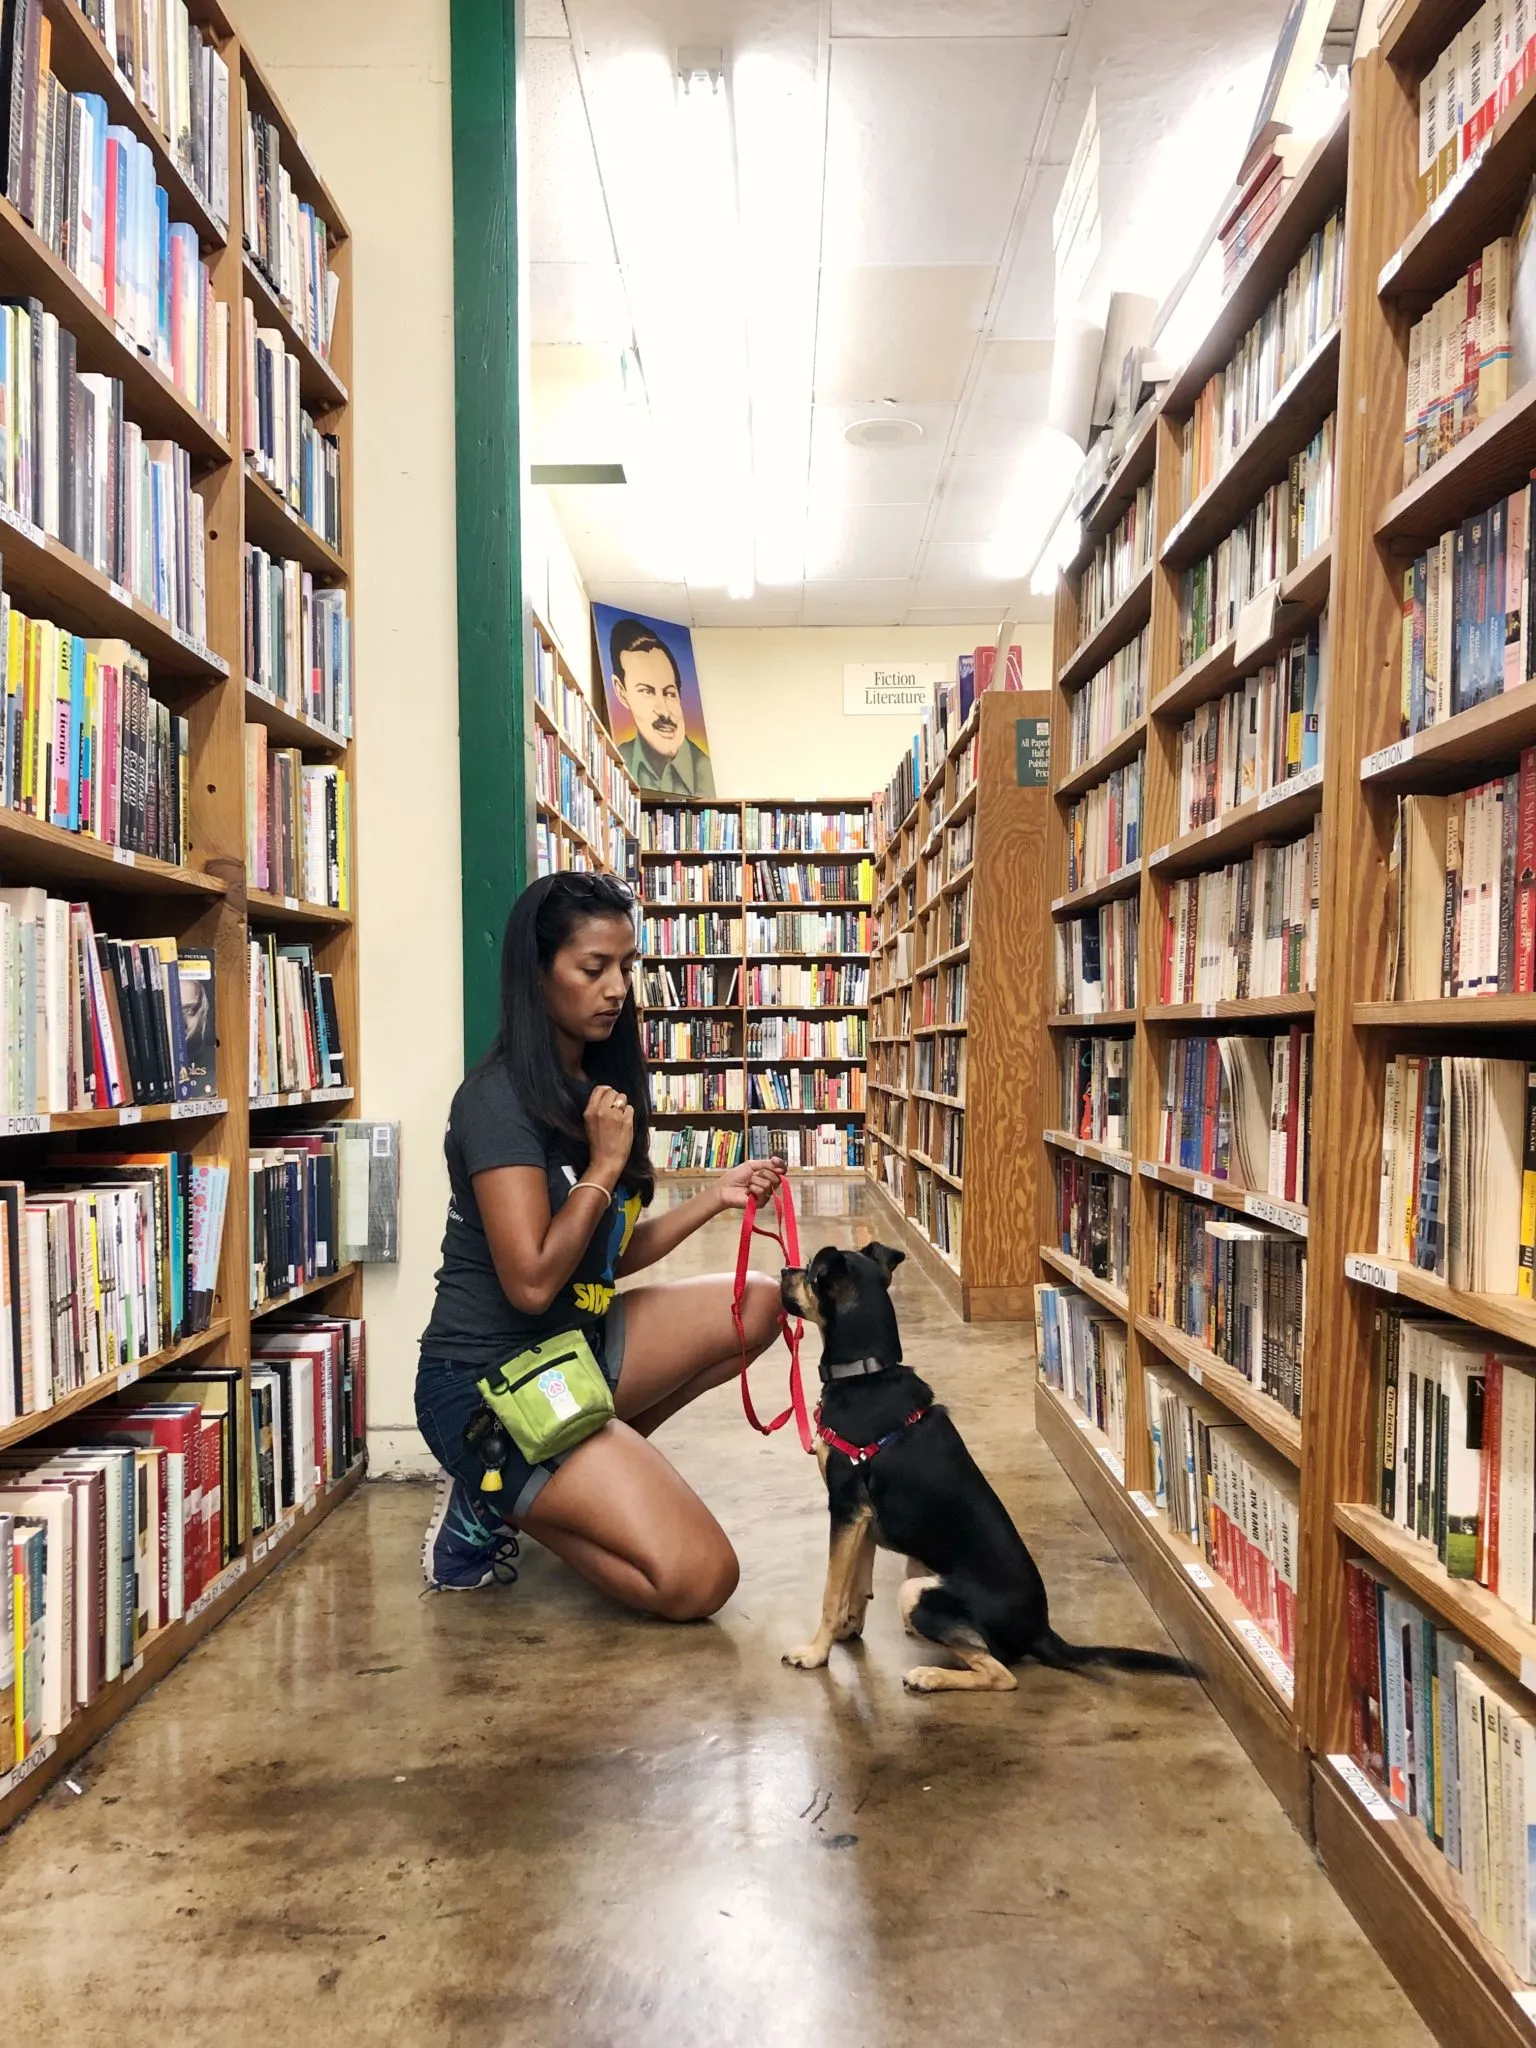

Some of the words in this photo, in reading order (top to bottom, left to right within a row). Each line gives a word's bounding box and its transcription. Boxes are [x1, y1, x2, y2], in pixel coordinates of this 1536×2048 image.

[61, 640, 69, 672] Girl
[874, 671, 916, 686] Fiction
[864, 690, 926, 705] Literature
[58, 712, 70, 768] Hornby
[1021, 738, 1030, 747] All
[1031, 738, 1049, 748] Paper
[1028, 759, 1049, 768] Publis
[1035, 768, 1049, 778] Pric
[1371, 749, 1403, 773] FICTION
[1522, 801, 1532, 862] SHAARA
[1312, 842, 1320, 887] Picoult
[1189, 897, 1197, 948] AMISTAD
[1443, 923, 1452, 973] MEASURE
[177, 1103, 194, 1117] ALPHA
[195, 1102, 202, 1114] BY
[203, 1100, 223, 1114] AUTHOR
[8, 1116, 41, 1134] FICTION
[1251, 1199, 1269, 1218] ALPHA
[1277, 1211, 1302, 1232] AUTHOR
[1354, 1260, 1388, 1287] FICTION
[1294, 1365, 1303, 1396] RAND
[1388, 1389, 1396, 1411] The
[1386, 1413, 1395, 1440] Irish
[1232, 1491, 1240, 1520] RAND
[1250, 1488, 1258, 1509] AYN
[1251, 1510, 1260, 1541] RAND
[1281, 1521, 1289, 1546] AYN
[1283, 1547, 1291, 1578] RAND
[125, 1574, 133, 1628] IRVING
[10, 1747, 47, 1787] FICTION
[1343, 1765, 1385, 1807] FICTION
